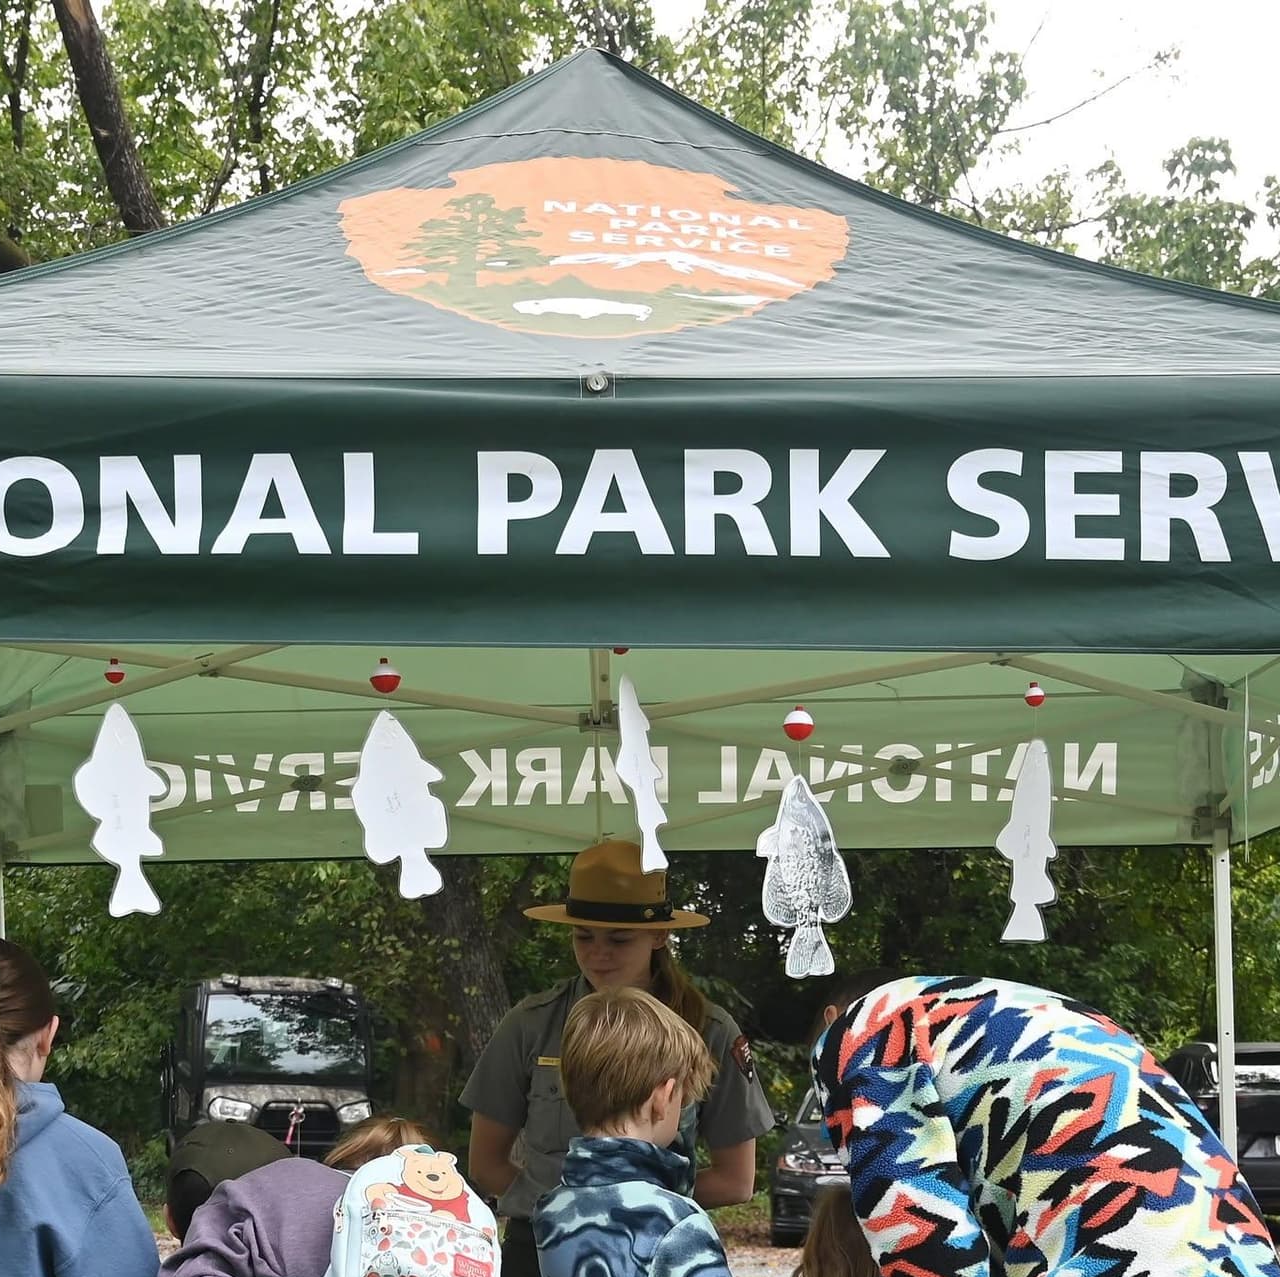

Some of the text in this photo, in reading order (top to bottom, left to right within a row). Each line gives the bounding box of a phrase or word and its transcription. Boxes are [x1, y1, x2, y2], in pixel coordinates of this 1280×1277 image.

[542, 199, 815, 232] NATIONAL
[609, 218, 746, 240] PARK
[567, 230, 793, 257] SERVICE
[476, 449, 891, 558] PARK
